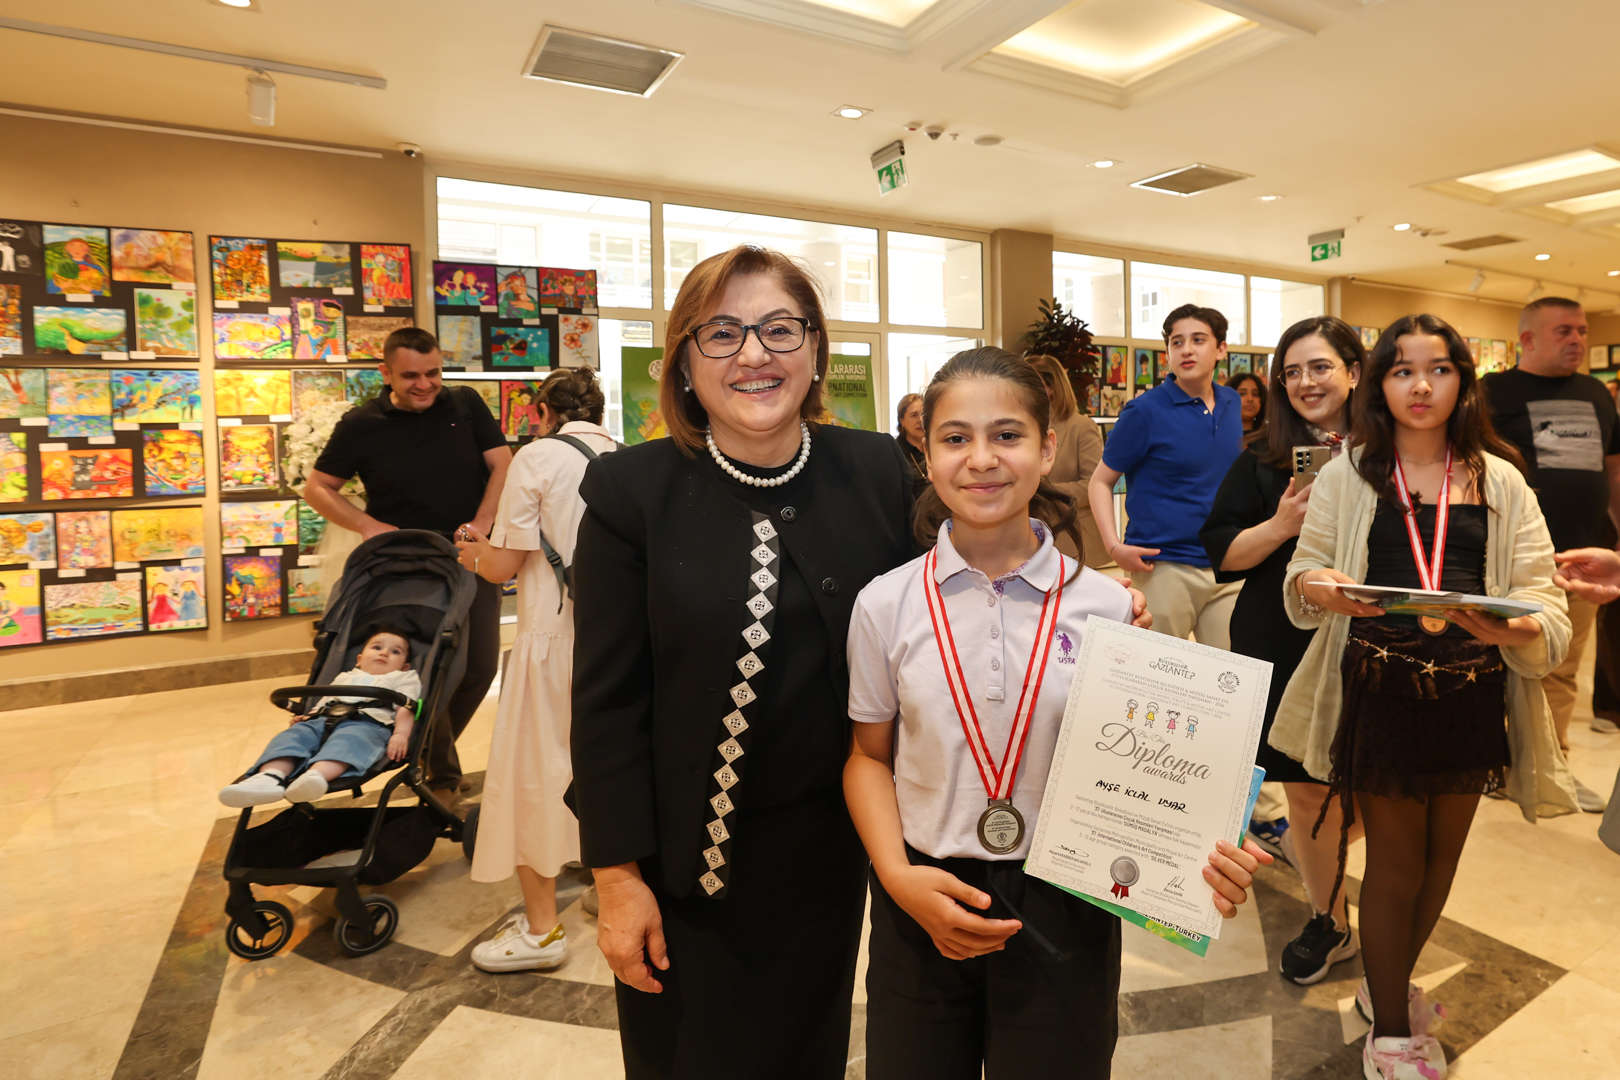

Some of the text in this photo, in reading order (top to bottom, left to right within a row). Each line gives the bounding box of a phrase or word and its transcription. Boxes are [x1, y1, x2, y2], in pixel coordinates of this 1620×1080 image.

[1095, 723, 1211, 780] Diploma
[1143, 766, 1187, 785] awards
[1095, 779, 1120, 793] AYŞE
[1158, 797, 1190, 814] UYAR
